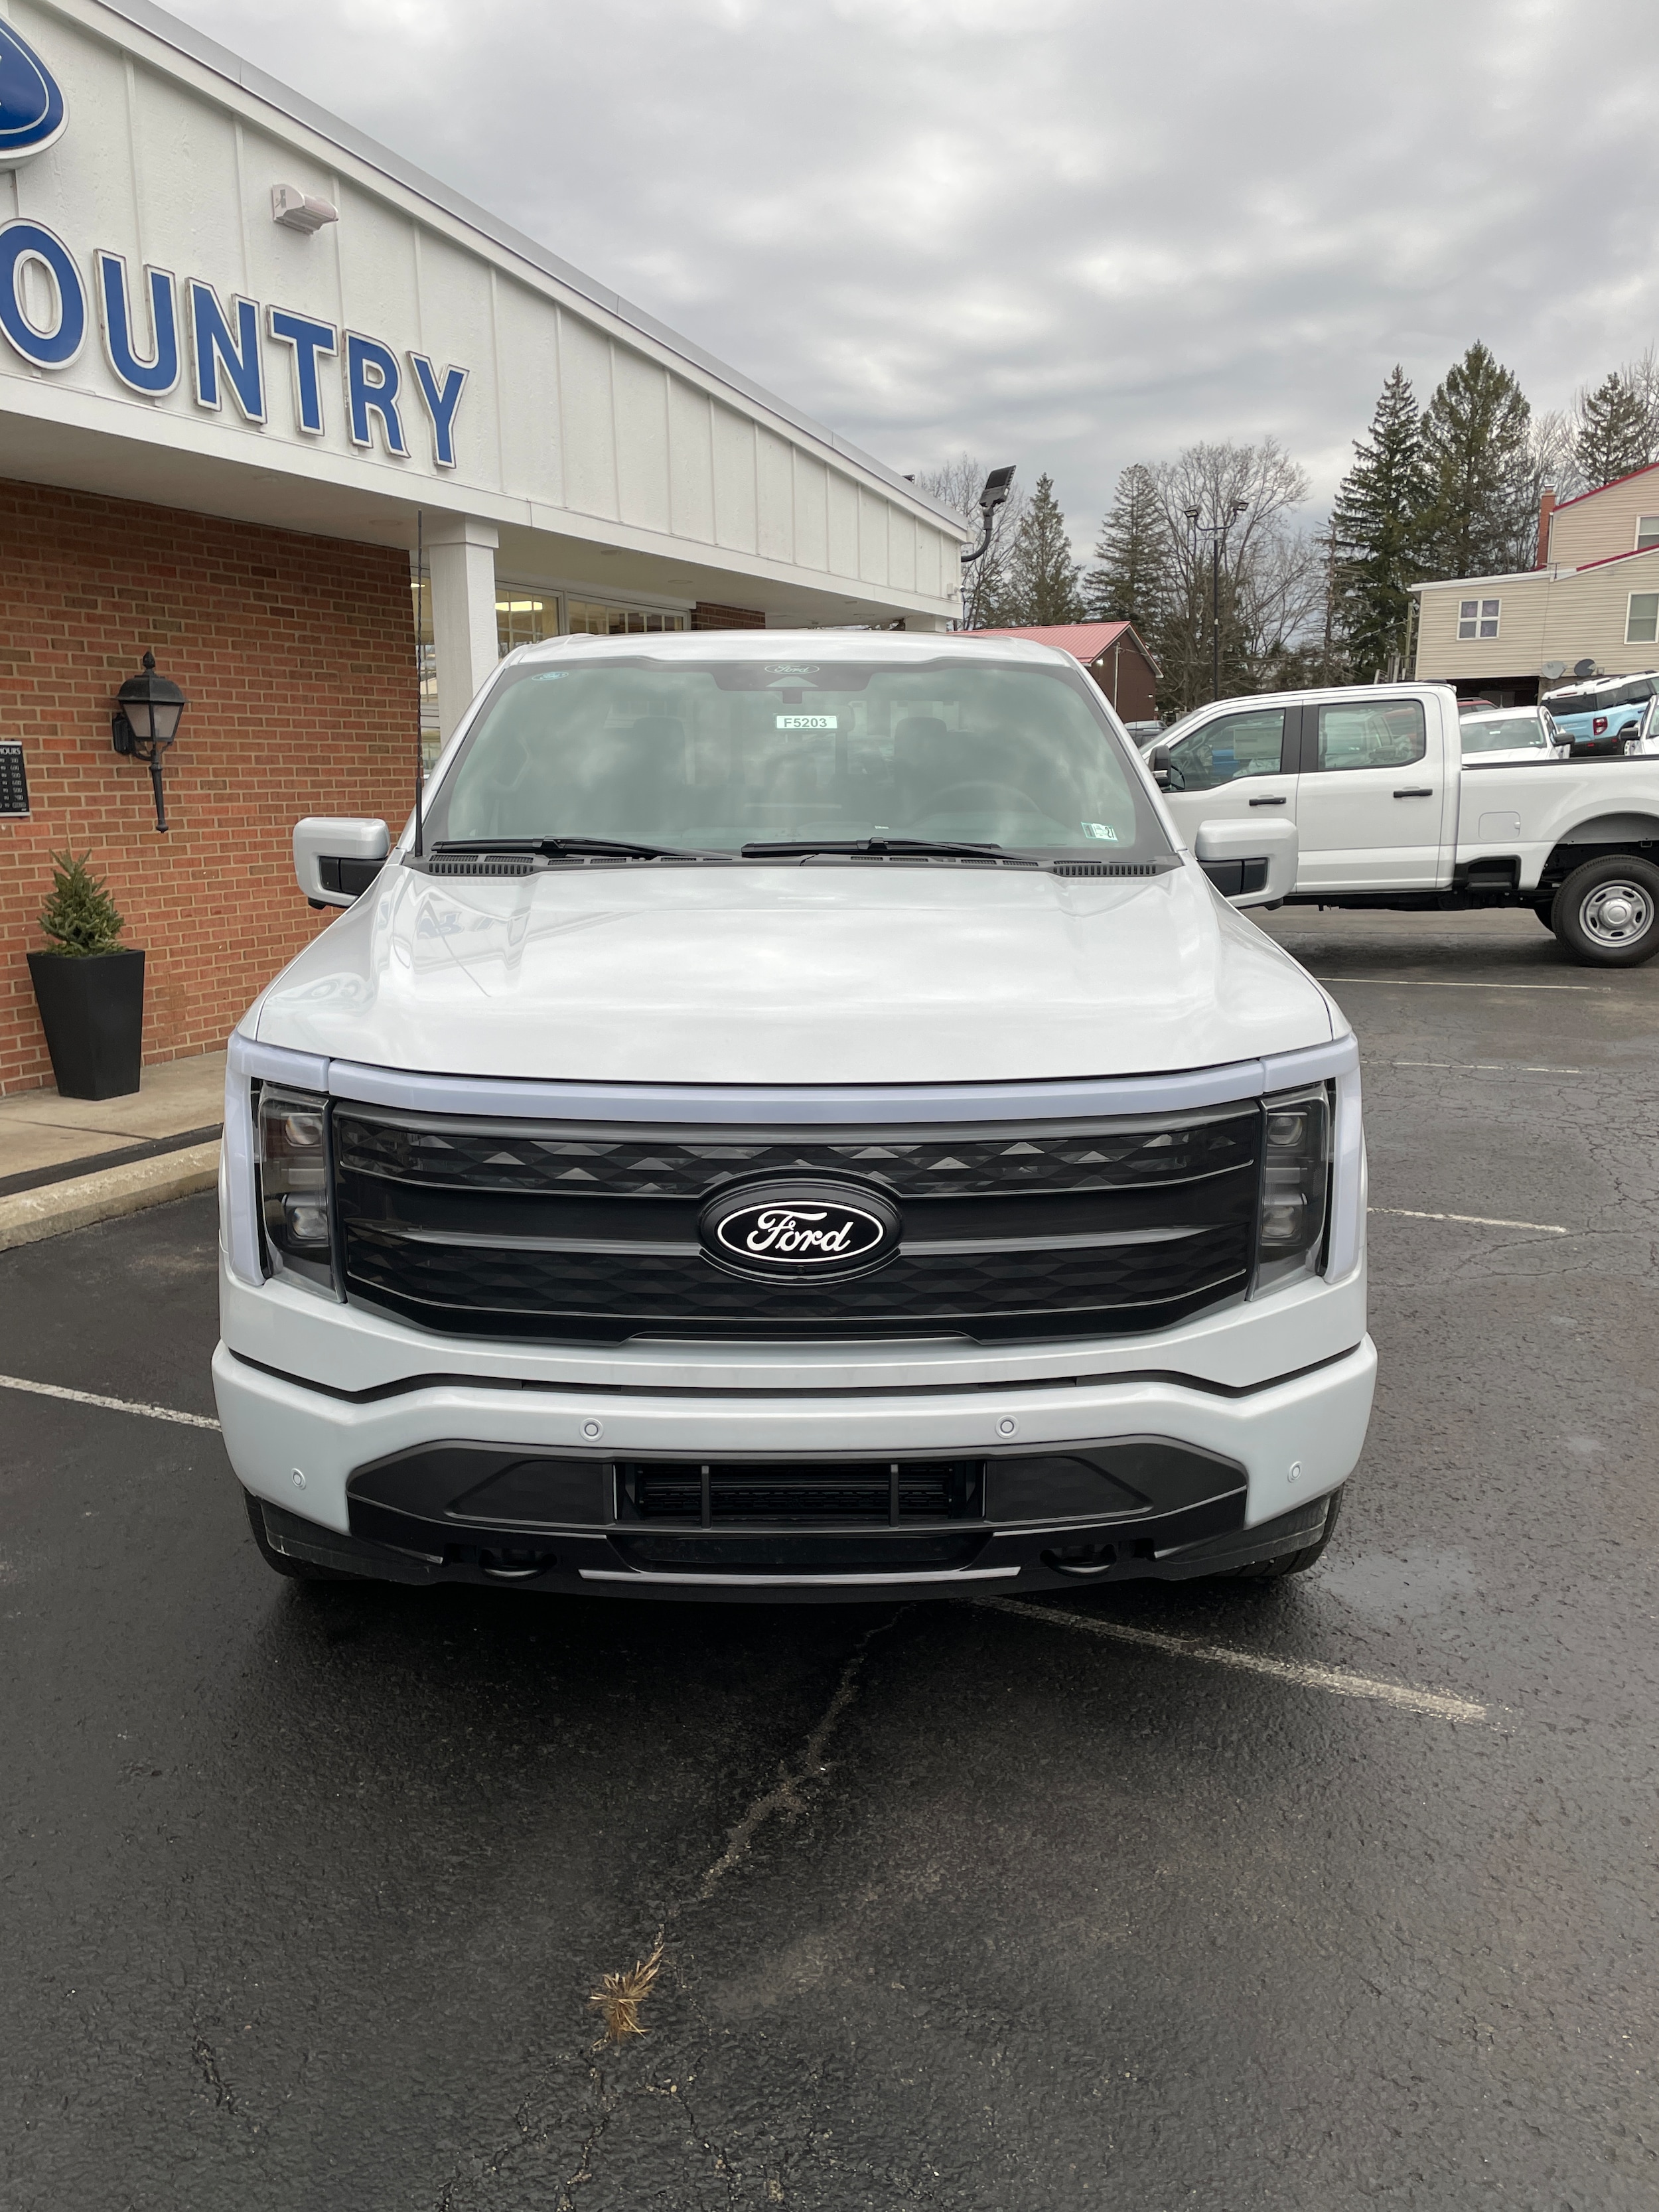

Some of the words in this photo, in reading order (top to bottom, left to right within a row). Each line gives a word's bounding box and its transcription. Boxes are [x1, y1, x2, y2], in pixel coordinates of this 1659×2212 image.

[0, 218, 470, 469] OUNTRY
[774, 664, 810, 673] Ford
[784, 718, 828, 727] F5203
[747, 1210, 854, 1252] Ford
